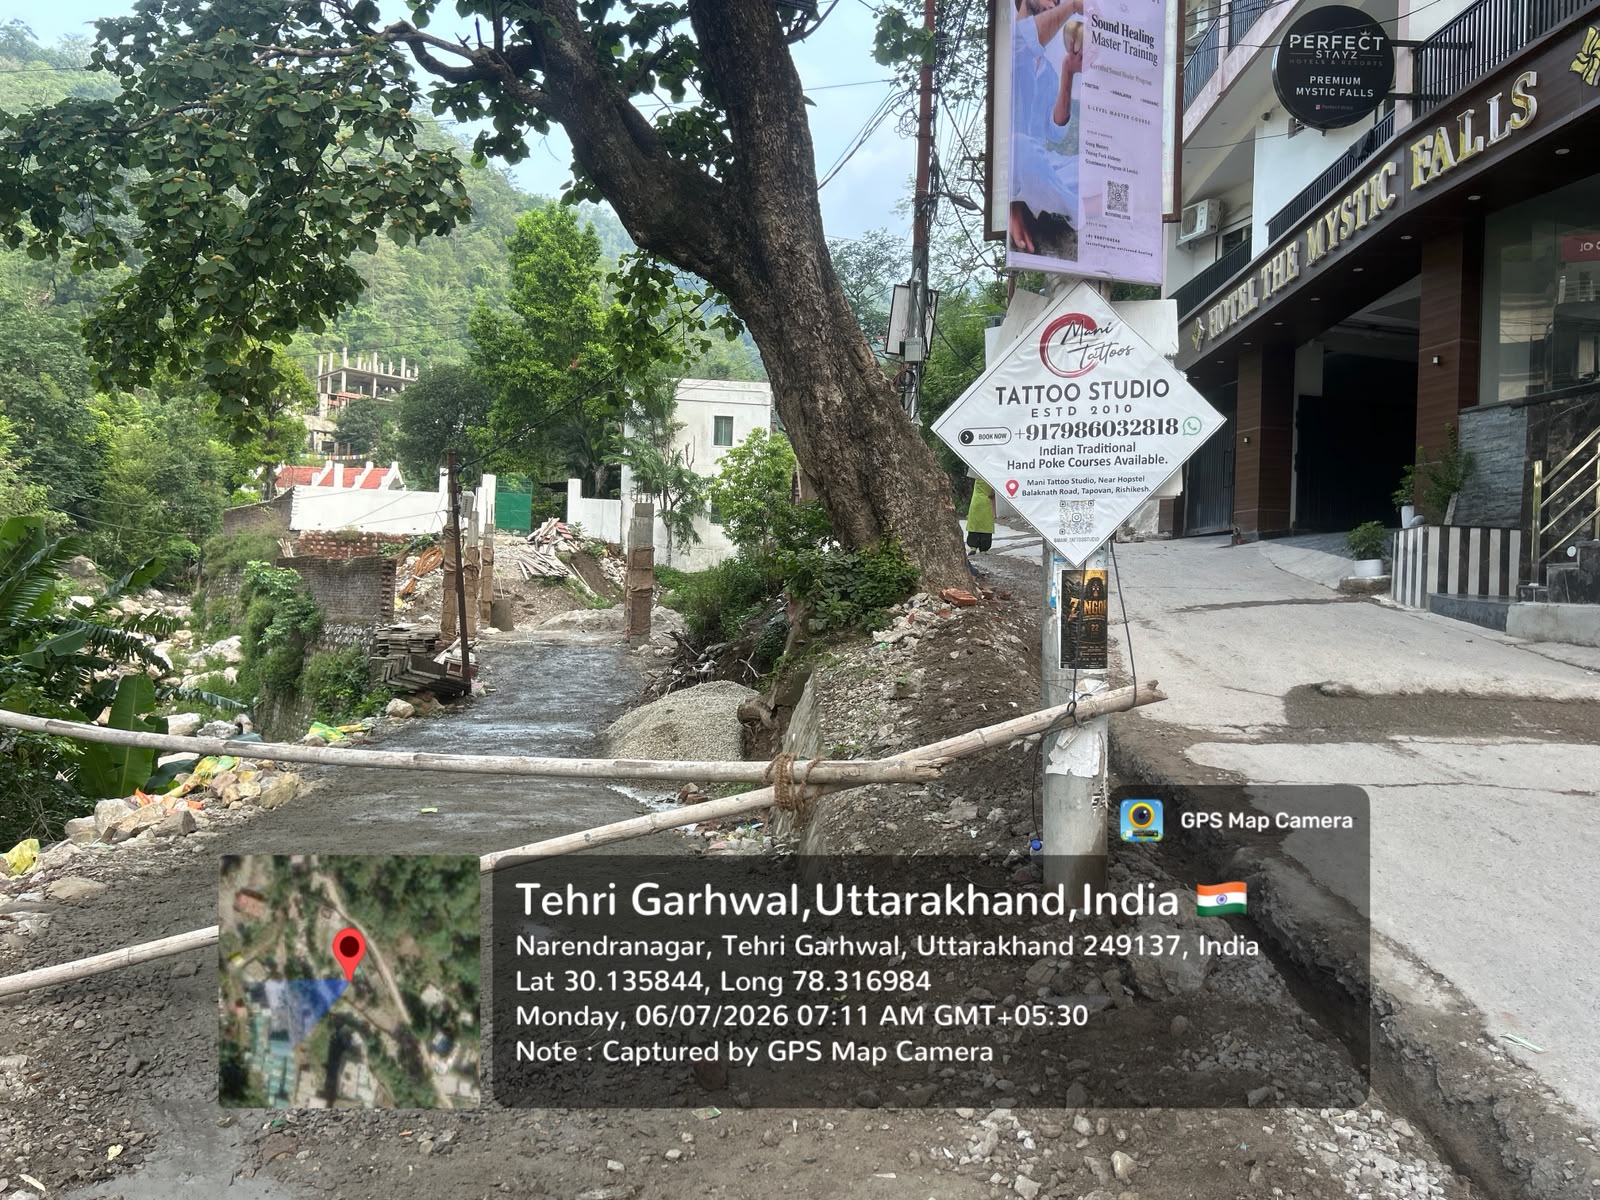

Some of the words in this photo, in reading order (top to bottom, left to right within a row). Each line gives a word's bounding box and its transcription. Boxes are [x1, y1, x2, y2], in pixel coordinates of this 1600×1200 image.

[1091, 13, 1120, 35] Sound
[1121, 23, 1155, 49] Healing
[1091, 30, 1122, 52] Master
[1122, 40, 1158, 67] Training
[1289, 34, 1384, 51] PERFECT
[1315, 50, 1358, 60] STAYZ
[1309, 75, 1361, 86] PREMIUM
[1295, 87, 1336, 96] MYSTIC
[1339, 88, 1374, 97] FALLS
[1109, 110, 1130, 120] MASTER
[1130, 116, 1151, 126] COURSE
[1208, 277, 1259, 341] HOTEL
[1261, 240, 1300, 301] THE
[1306, 162, 1397, 267] MYSTIC
[1410, 71, 1538, 191] FALLS
[1060, 320, 1113, 346] Mani
[1067, 341, 1135, 370] Tattoos
[995, 383, 1081, 406] TATTOO
[1088, 378, 1170, 401] STUDIO
[1031, 406, 1077, 418] ESTD
[1090, 404, 1132, 415] 2010
[978, 433, 994, 441] BOOK
[993, 432, 1008, 440] NOW
[1014, 417, 1179, 441] +917986032818
[1039, 445, 1074, 456] Indian
[1076, 441, 1136, 455] Traditional
[1007, 459, 1036, 471] Hand
[1038, 457, 1065, 469] Poke
[1068, 456, 1111, 468] Courses
[1114, 453, 1168, 466] Available.
[1071, 477, 1097, 485] Studio,
[1117, 475, 1145, 485] Hopstel
[1022, 489, 1057, 497] Balaknath
[1059, 488, 1080, 497] Road,
[1081, 487, 1114, 496] Tapovan,
[1115, 485, 1151, 494] Rishikesh.
